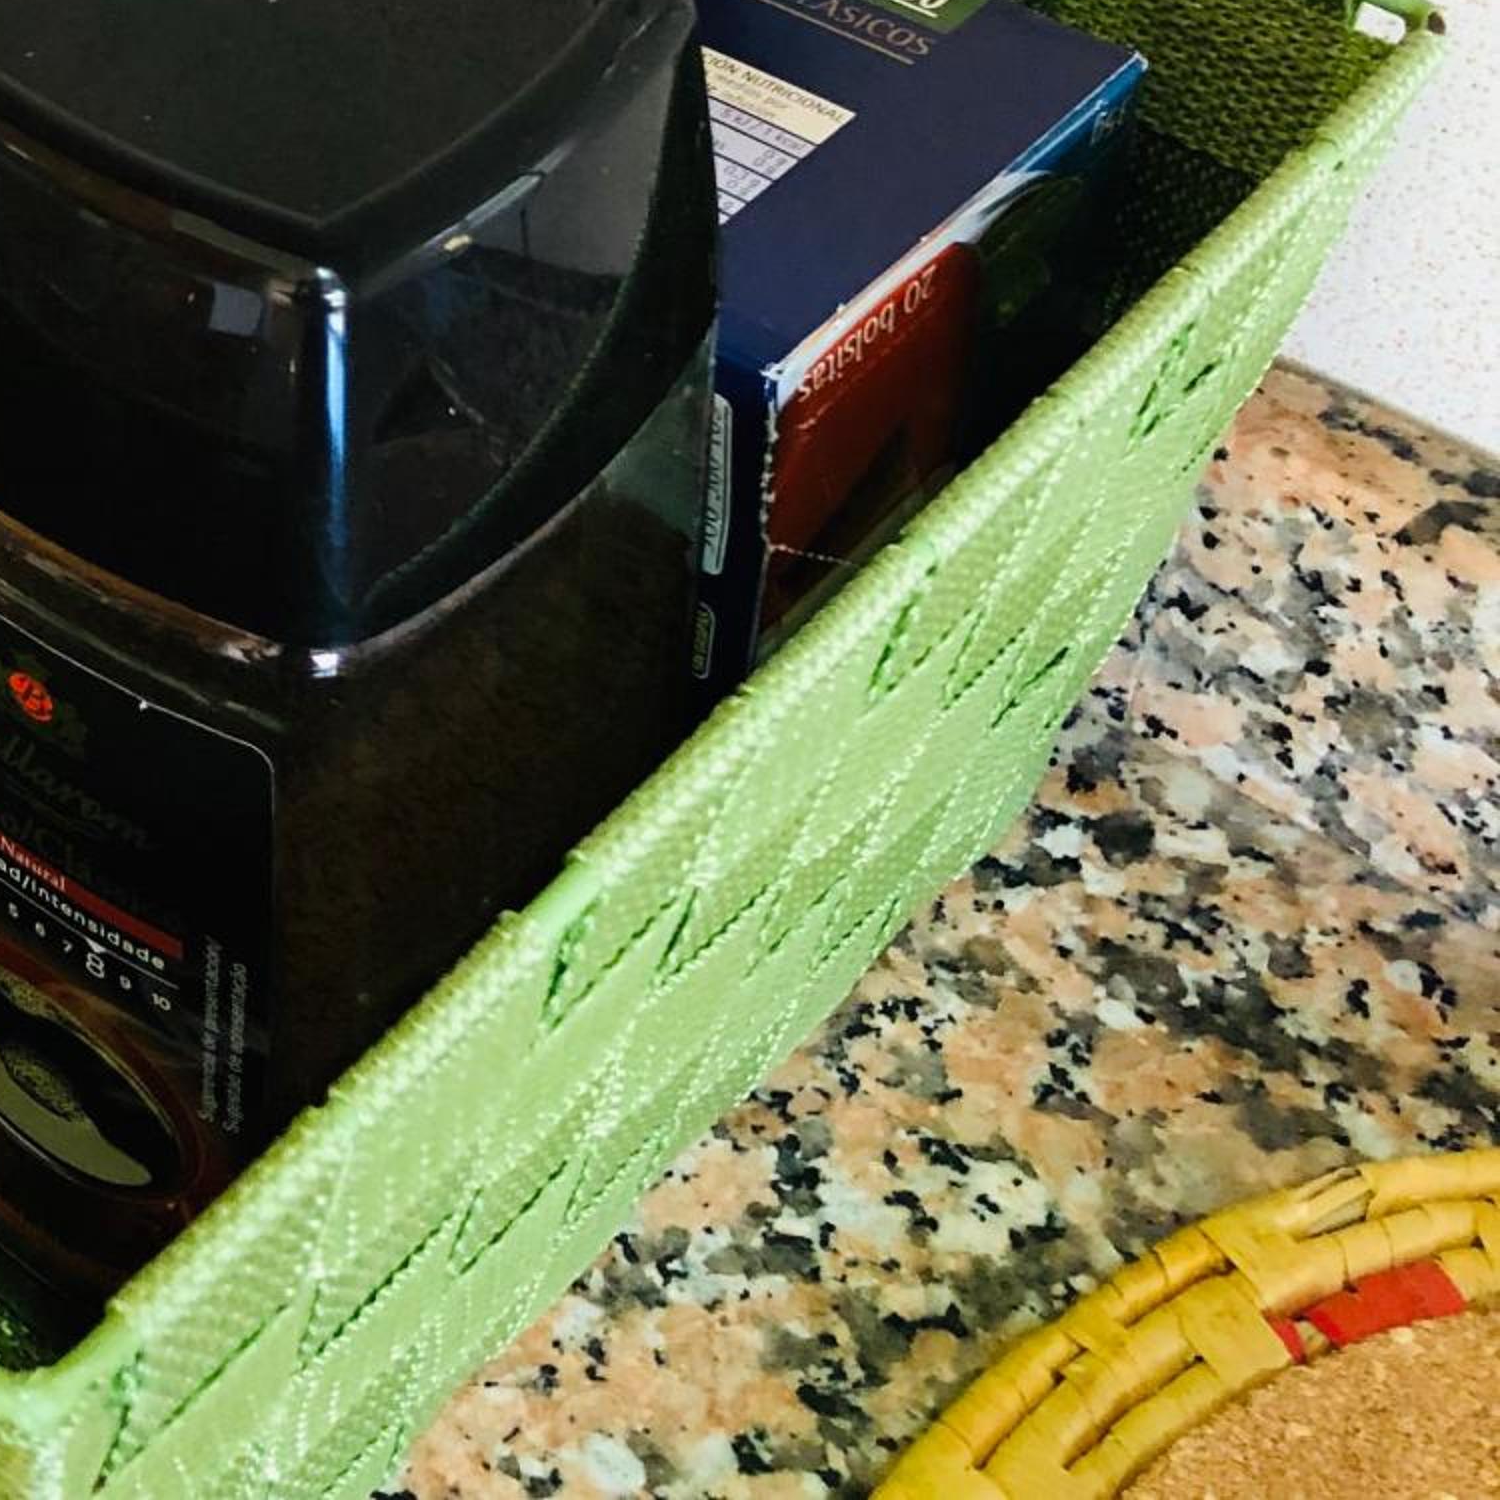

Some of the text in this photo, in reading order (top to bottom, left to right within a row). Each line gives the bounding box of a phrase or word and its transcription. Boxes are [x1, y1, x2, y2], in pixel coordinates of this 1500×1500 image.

[741, 69, 844, 123] NUTRICIONAL
[797, 264, 939, 403] 20 bolsitas
[0, 834, 68, 892] Natural
[8, 901, 20, 919] 5
[34, 920, 47, 938] 6
[61, 938, 74, 953] 7
[85, 951, 106, 979] 8
[119, 973, 132, 991] 9
[152, 992, 172, 1011] 10
